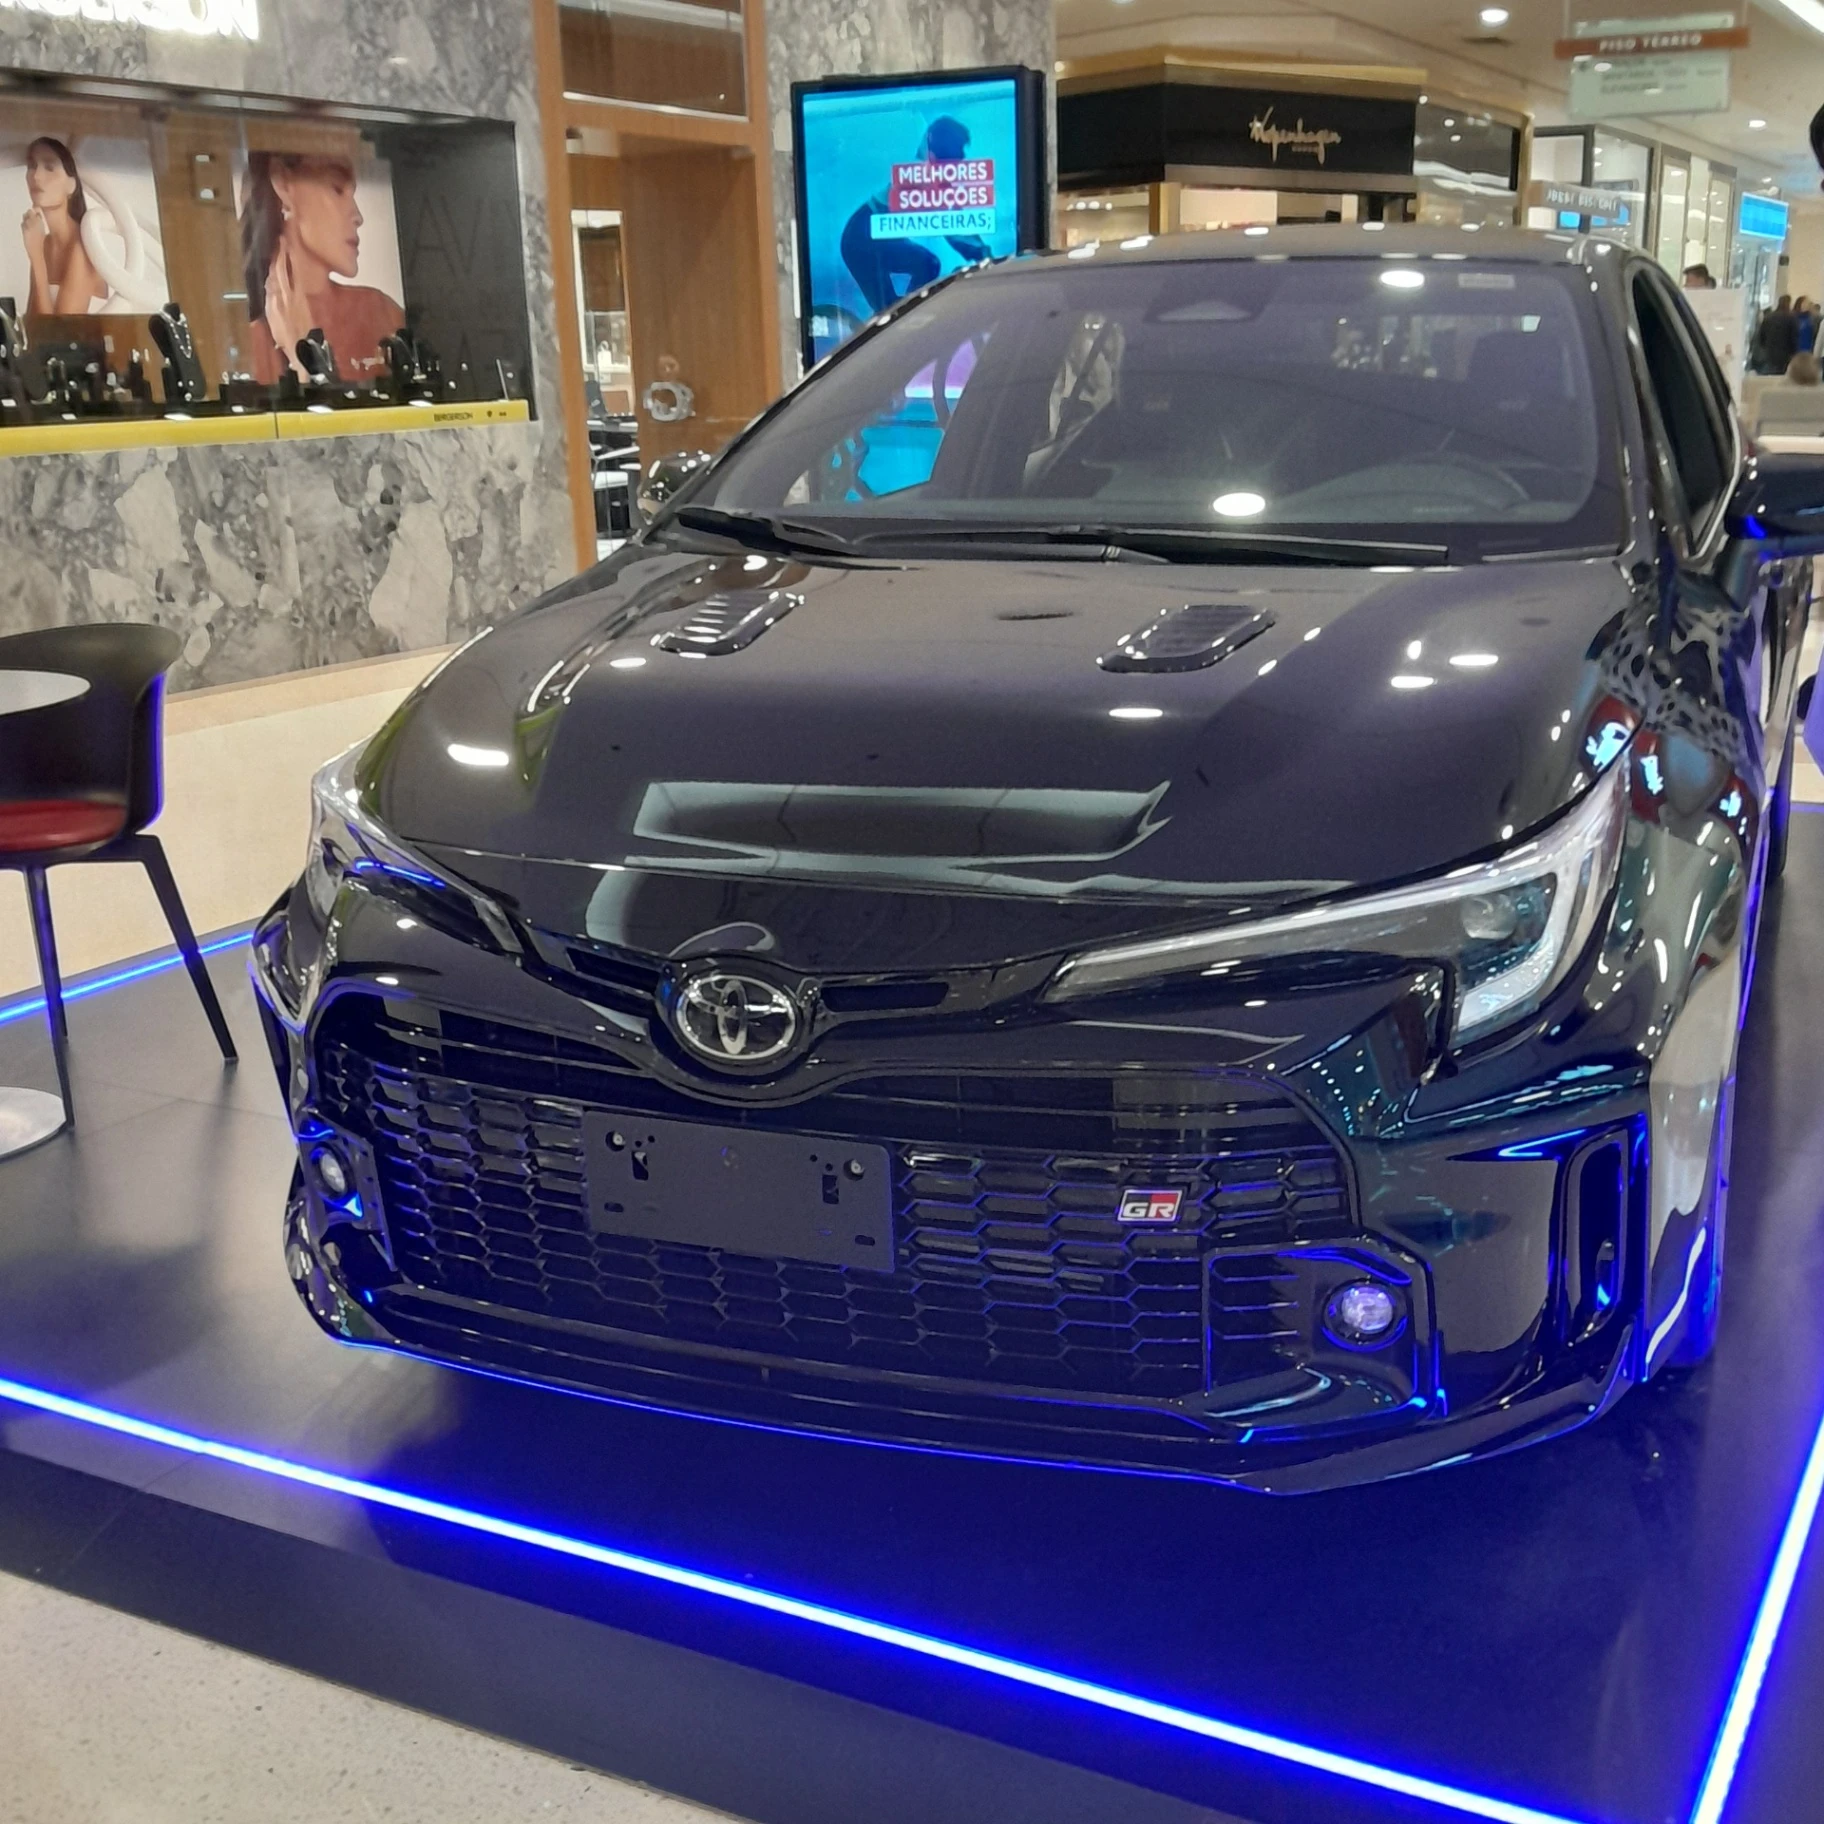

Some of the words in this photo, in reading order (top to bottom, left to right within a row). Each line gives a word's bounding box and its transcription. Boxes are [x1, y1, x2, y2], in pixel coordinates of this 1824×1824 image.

[898, 161, 988, 184] MELHORES
[899, 184, 988, 211] SOLUÇÕES
[1122, 1201, 1175, 1219] GR
